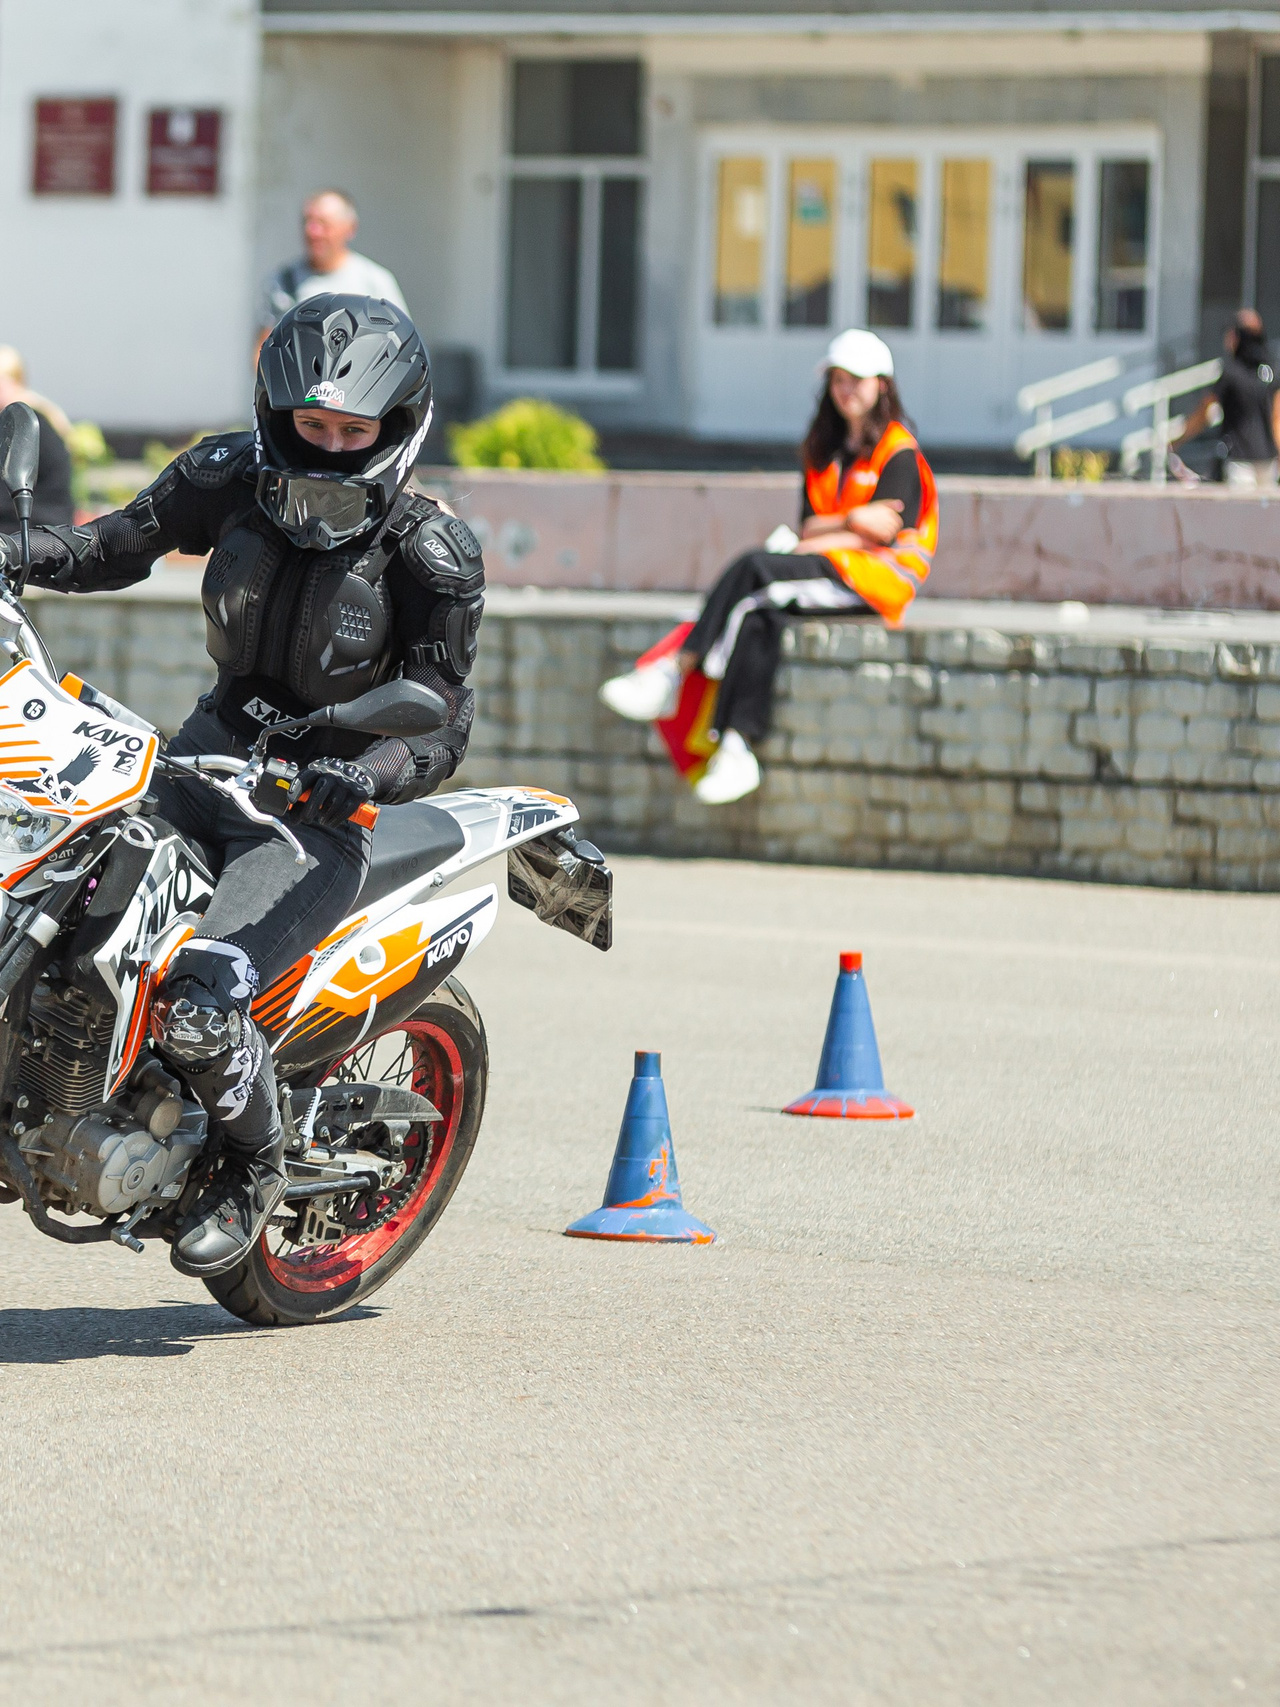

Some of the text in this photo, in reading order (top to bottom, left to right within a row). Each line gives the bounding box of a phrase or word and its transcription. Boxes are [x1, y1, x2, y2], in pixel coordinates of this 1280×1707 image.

[26, 701, 44, 718] 15
[73, 721, 144, 752] KAYO
[426, 928, 472, 969] KAYO
